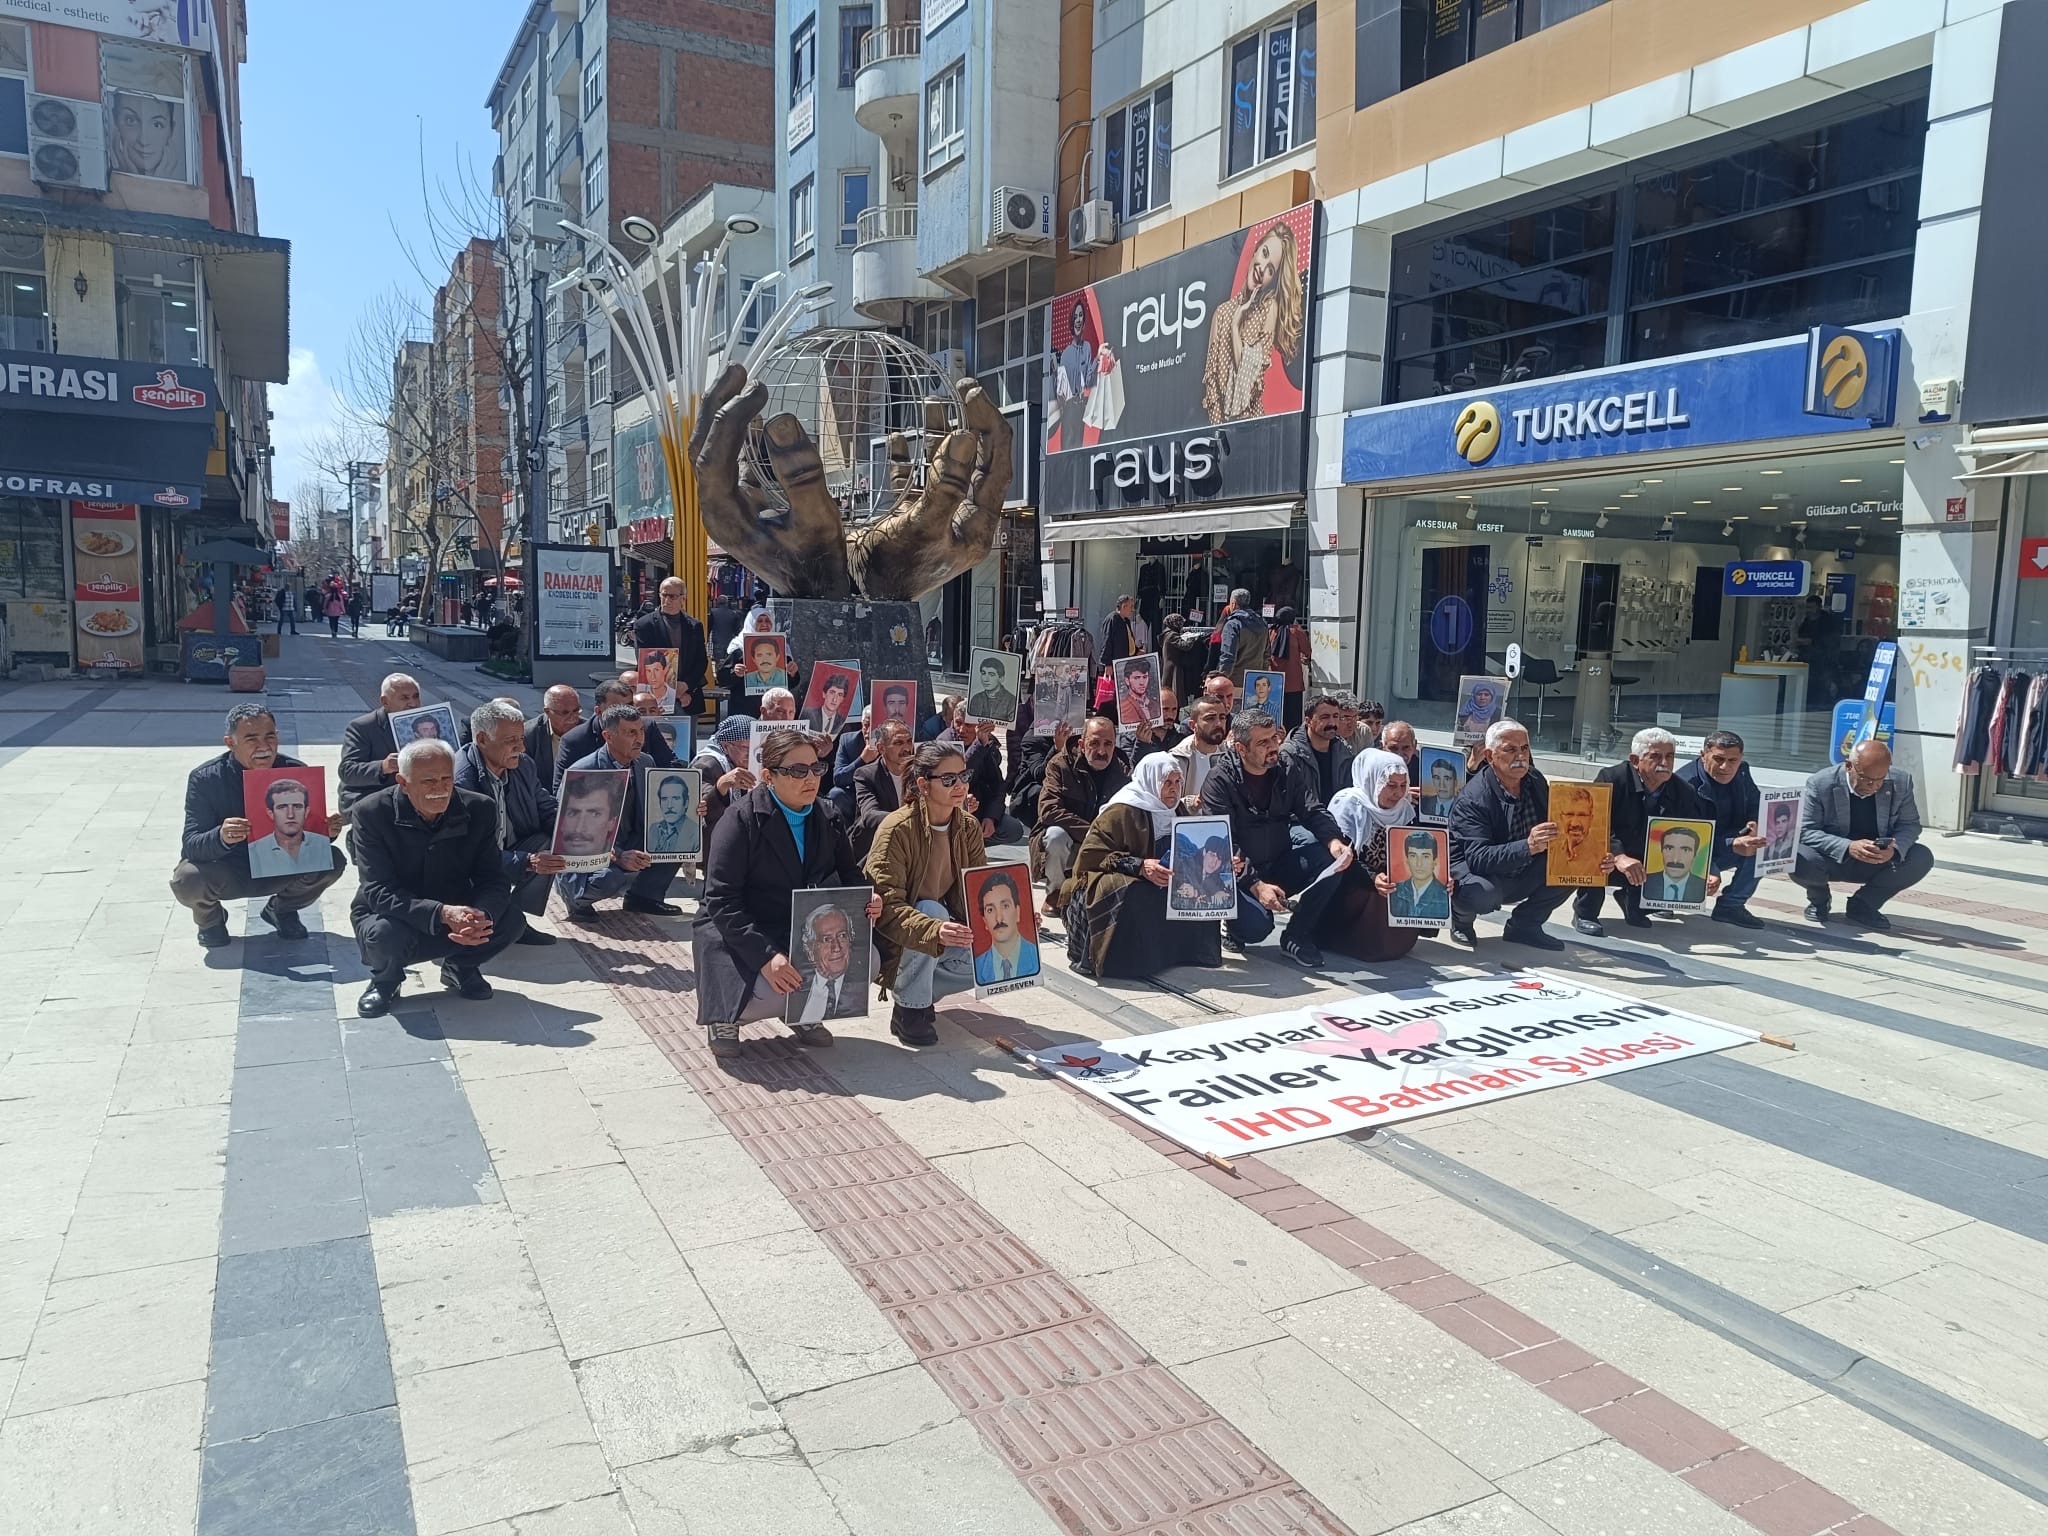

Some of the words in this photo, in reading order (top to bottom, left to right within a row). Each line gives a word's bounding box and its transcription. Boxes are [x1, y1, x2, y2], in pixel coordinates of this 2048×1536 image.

[63, 8, 110, 23] esthetic
[1133, 126, 1147, 209] DENT
[1121, 280, 1207, 350] rays
[1150, 361, 1158, 370] de
[141, 388, 197, 406] şenpiliç
[1512, 387, 1689, 443] TURKCELL
[1089, 436, 1213, 497] rays
[157, 495, 185, 504] şenpiliç
[1806, 503, 1848, 517] Gülistan
[1850, 502, 1873, 514] Cad.
[1415, 519, 1458, 530] AKSESUAR
[1562, 528, 1595, 538] SAMSUNG
[543, 571, 603, 593] RAMAZAN
[1746, 570, 1796, 582] TURKCELL
[92, 581, 123, 592] şenpiliç
[1756, 581, 1795, 589] SUPERONLINE
[755, 722, 785, 733] İBRAHİM
[1764, 791, 1780, 801] EDİP
[1782, 789, 1802, 800] ÇELİK
[678, 853, 696, 862] ÇELİK
[566, 859, 588, 869] seyin
[1558, 875, 1577, 884] TAHİR
[1578, 875, 1593, 885] ELÇİ
[1424, 919, 1446, 927] MALTU
[986, 985, 1008, 996] İZZET
[1010, 979, 1034, 992] SEVEN
[1121, 1023, 1328, 1067] Kayıplar
[1322, 988, 1530, 1032] Bulunsun
[1108, 1062, 1341, 1115] Failler
[1331, 1003, 1671, 1071] Yargılansın
[1206, 1106, 1332, 1141] İHD
[1329, 1067, 1543, 1117] Batman
[1527, 1031, 1695, 1077] Şubesi
